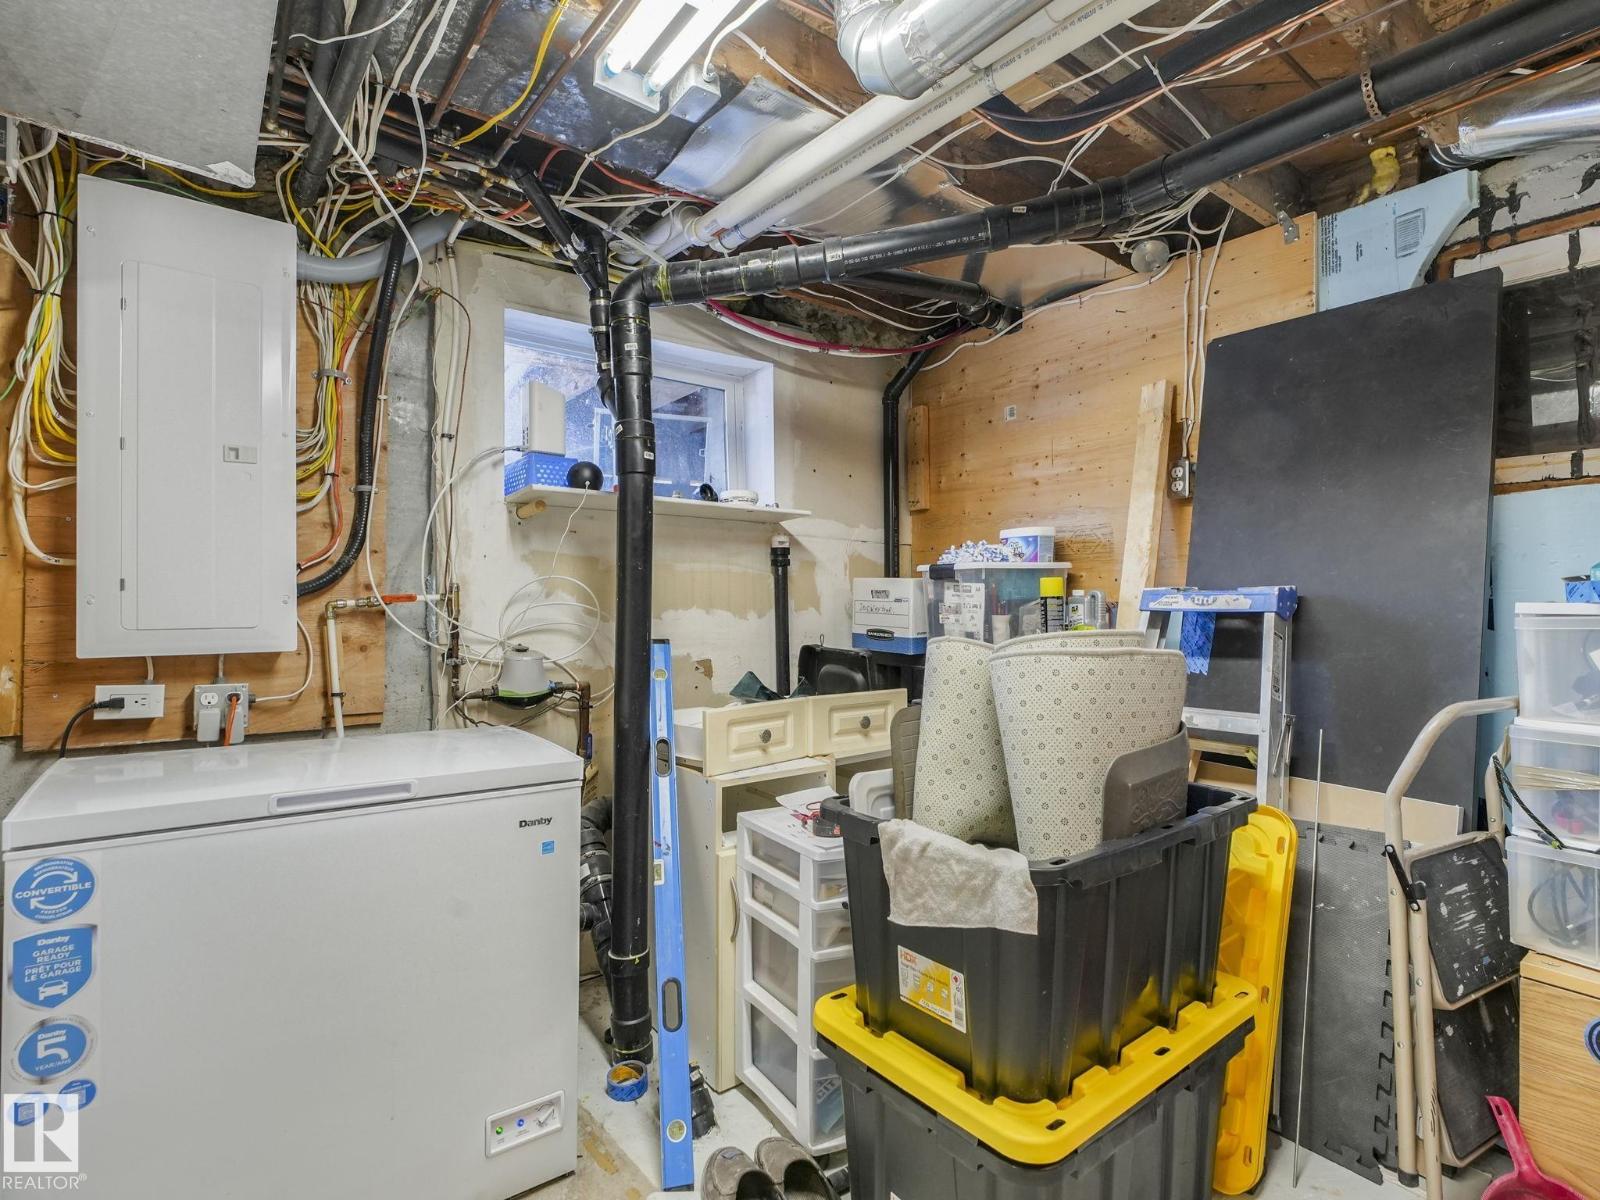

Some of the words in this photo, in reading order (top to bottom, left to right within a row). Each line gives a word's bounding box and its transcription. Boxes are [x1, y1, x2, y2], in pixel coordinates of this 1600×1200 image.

[519, 817, 553, 828] Danby
[15, 881, 93, 899] CONVERTIBLE
[37, 935, 70, 946] Danby
[32, 944, 75, 957] GARAGE
[37, 952, 71, 963] READY
[54, 960, 81, 970] POUR
[25, 973, 37, 983] LE
[40, 965, 81, 979] GARAGE
[37, 1034, 69, 1060] 5
